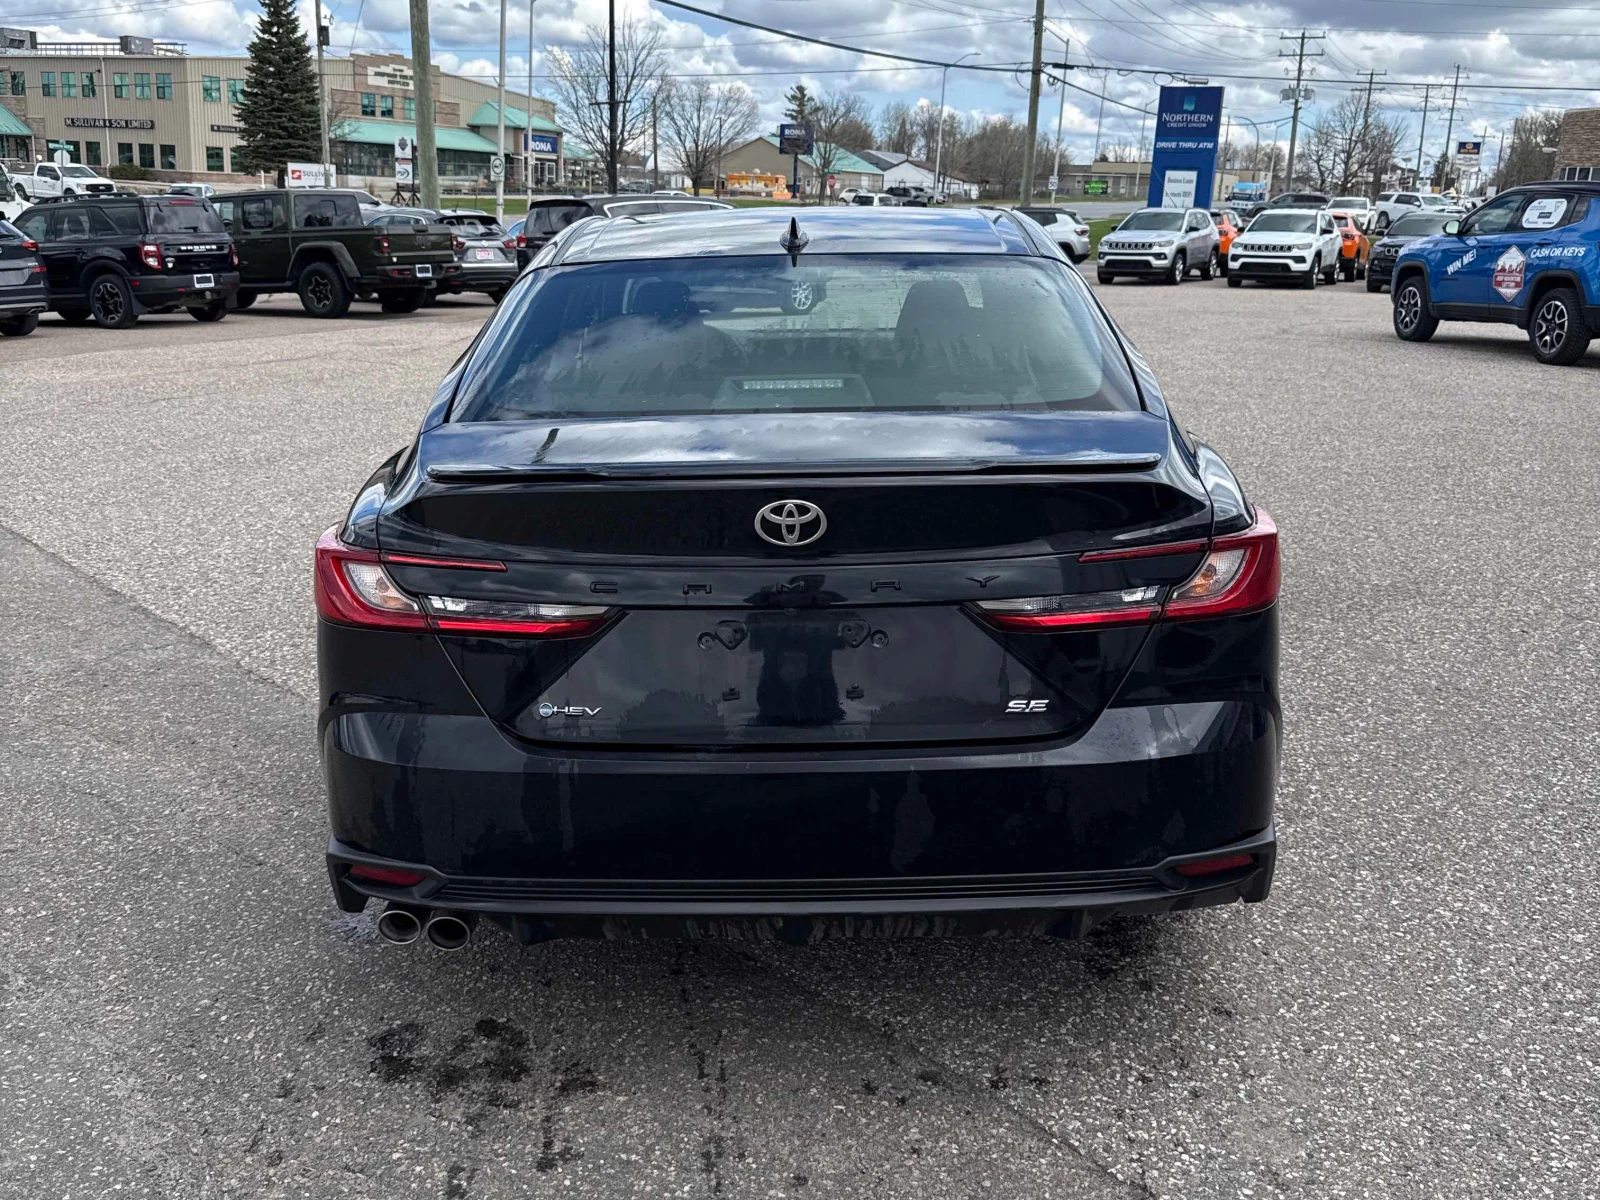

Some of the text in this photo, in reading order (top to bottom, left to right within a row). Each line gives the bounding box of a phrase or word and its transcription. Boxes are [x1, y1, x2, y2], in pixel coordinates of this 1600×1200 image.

[1162, 112, 1214, 122] NORTHERN
[73, 118, 104, 127] SULLIVAN
[111, 119, 126, 128] SON
[128, 120, 152, 128] LIMITED
[531, 141, 552, 152] RONA
[1156, 141, 1177, 149] DRIVE
[302, 170, 334, 178] SULLIVN
[1530, 247, 1586, 258] CASH OR KEYS
[1446, 249, 1477, 275] WIN ME!
[589, 575, 1001, 595] CAMRY
[553, 705, 603, 716] HEV
[1005, 699, 1050, 713] SE
